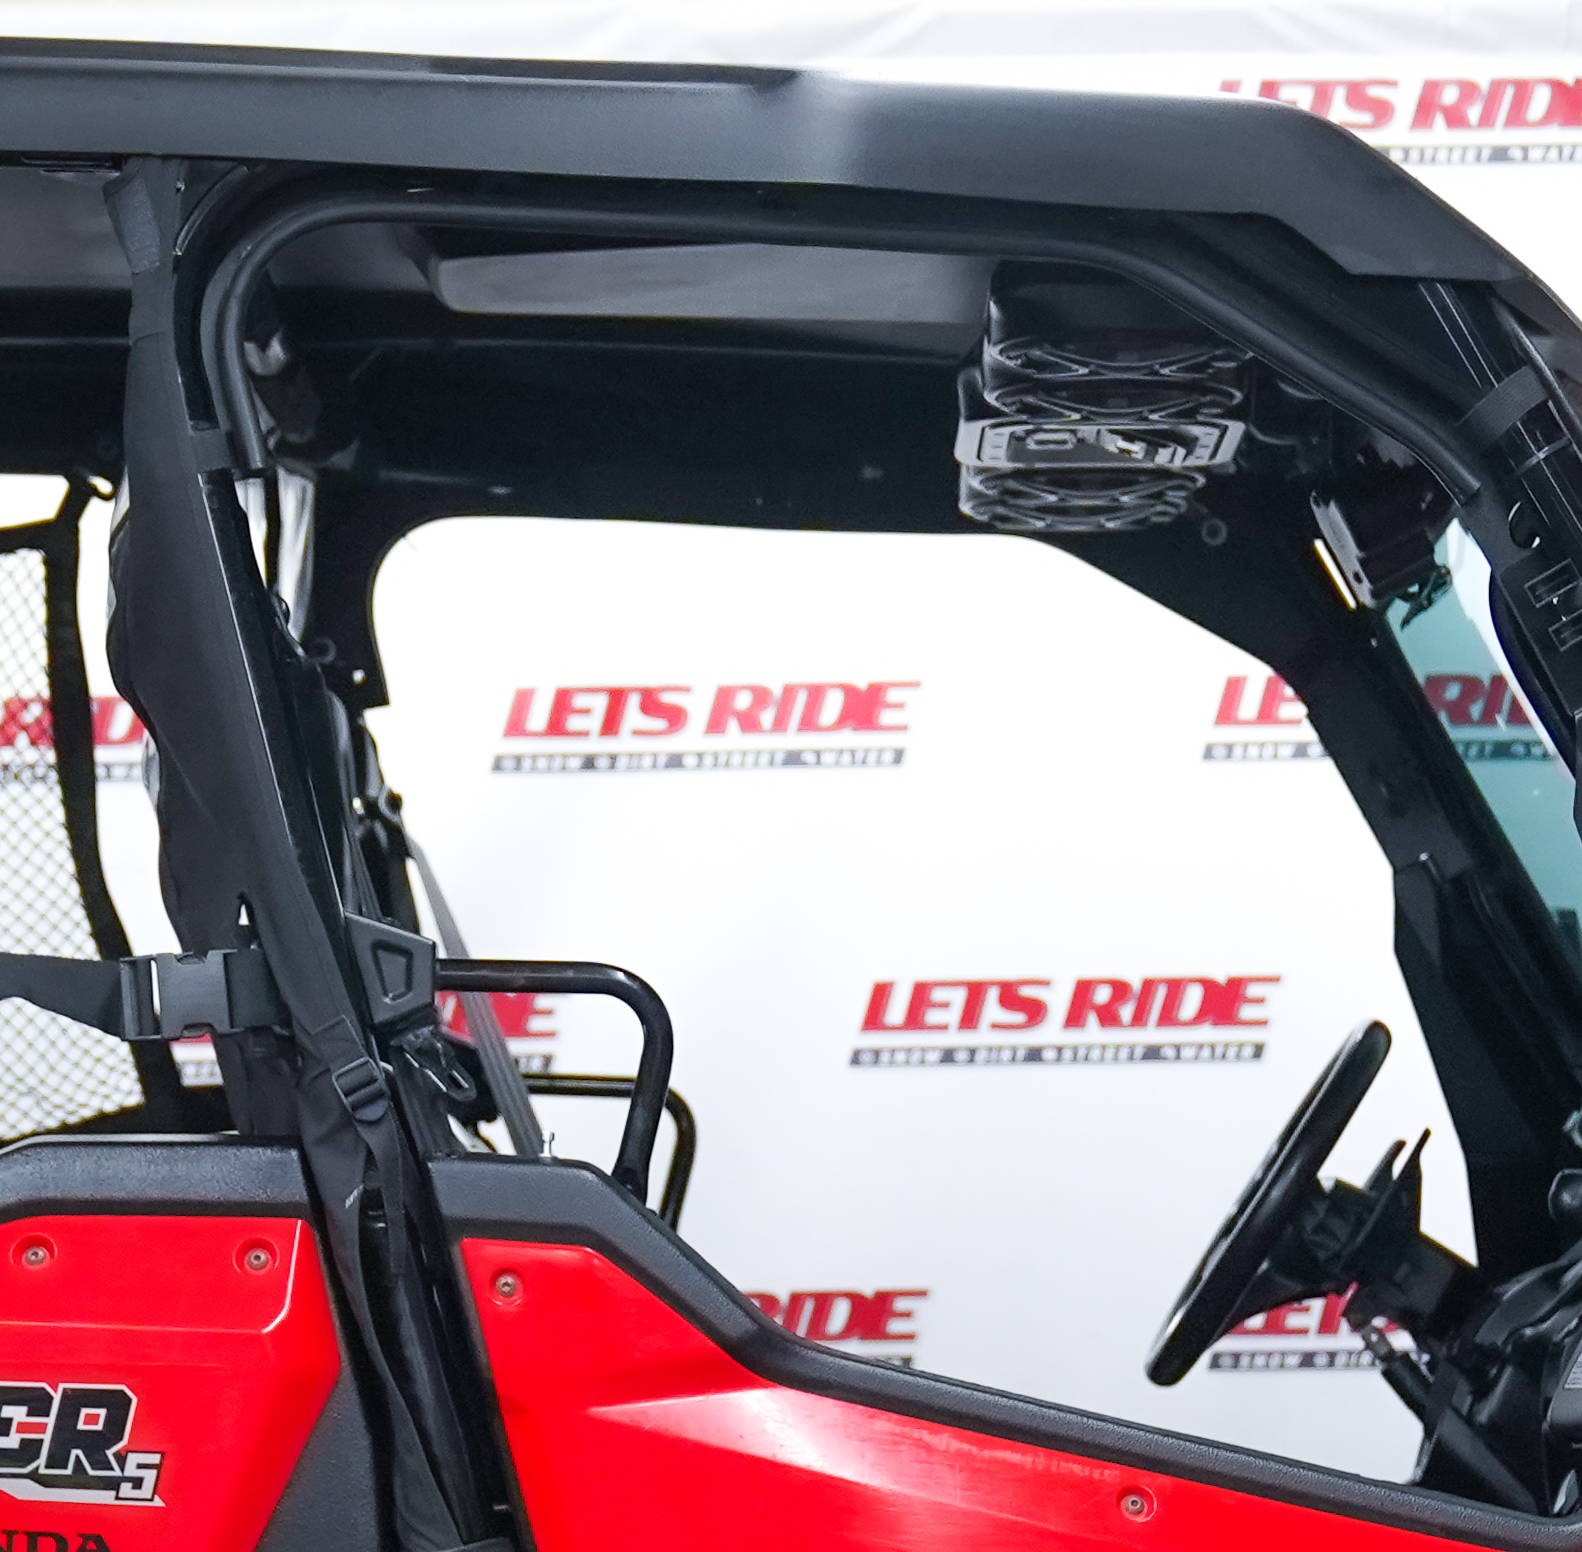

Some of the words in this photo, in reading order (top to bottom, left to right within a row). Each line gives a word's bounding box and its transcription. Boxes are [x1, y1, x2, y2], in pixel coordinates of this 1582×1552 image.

[1219, 79, 1398, 130] TS
[503, 686, 692, 737] LETS
[704, 681, 921, 735] RIDE
[1214, 675, 1307, 726] LE
[1424, 674, 1532, 726] RI
[860, 981, 1052, 1031] LETS
[1062, 976, 1281, 1029] RIDE
[117, 1451, 165, 1502] 5
